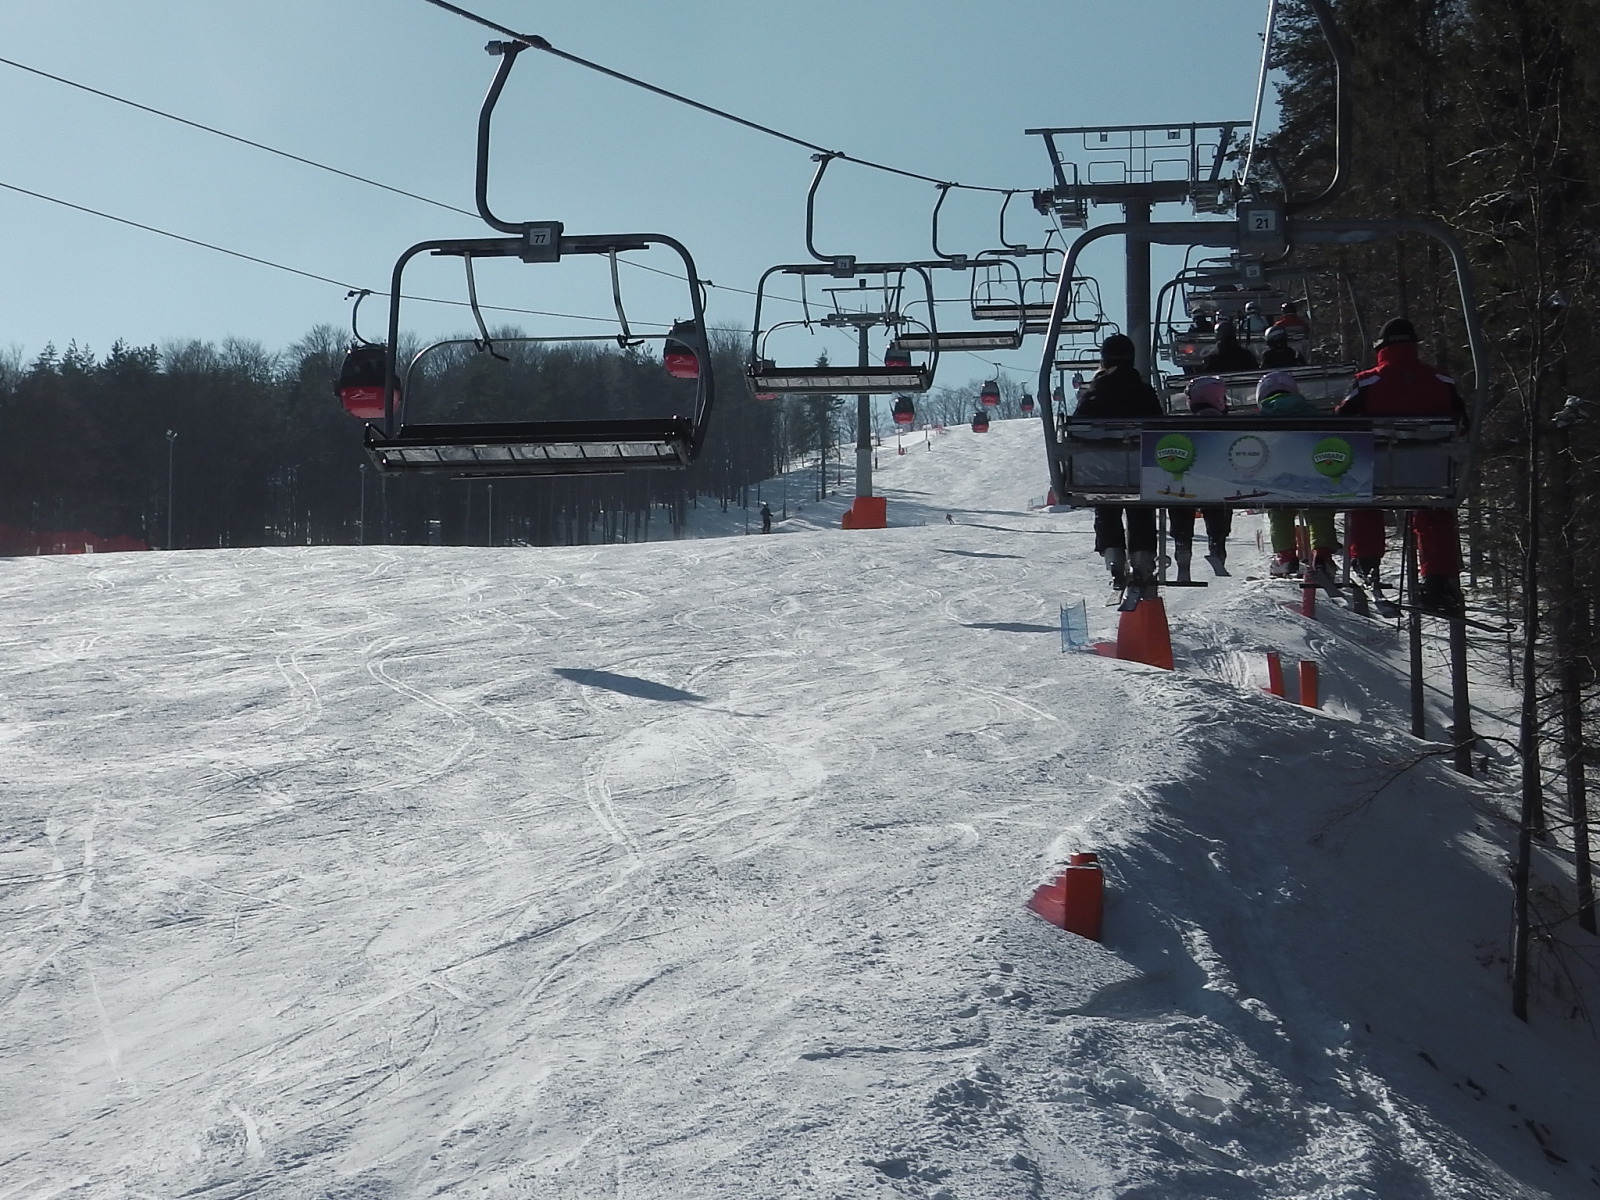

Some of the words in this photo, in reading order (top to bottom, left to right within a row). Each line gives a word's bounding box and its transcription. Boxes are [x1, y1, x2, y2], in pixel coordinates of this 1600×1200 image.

[1255, 217, 1269, 229] 21
[534, 234, 547, 244] 77
[1157, 448, 1187, 458] TYMBARK
[1314, 452, 1344, 462] TYMBARK
